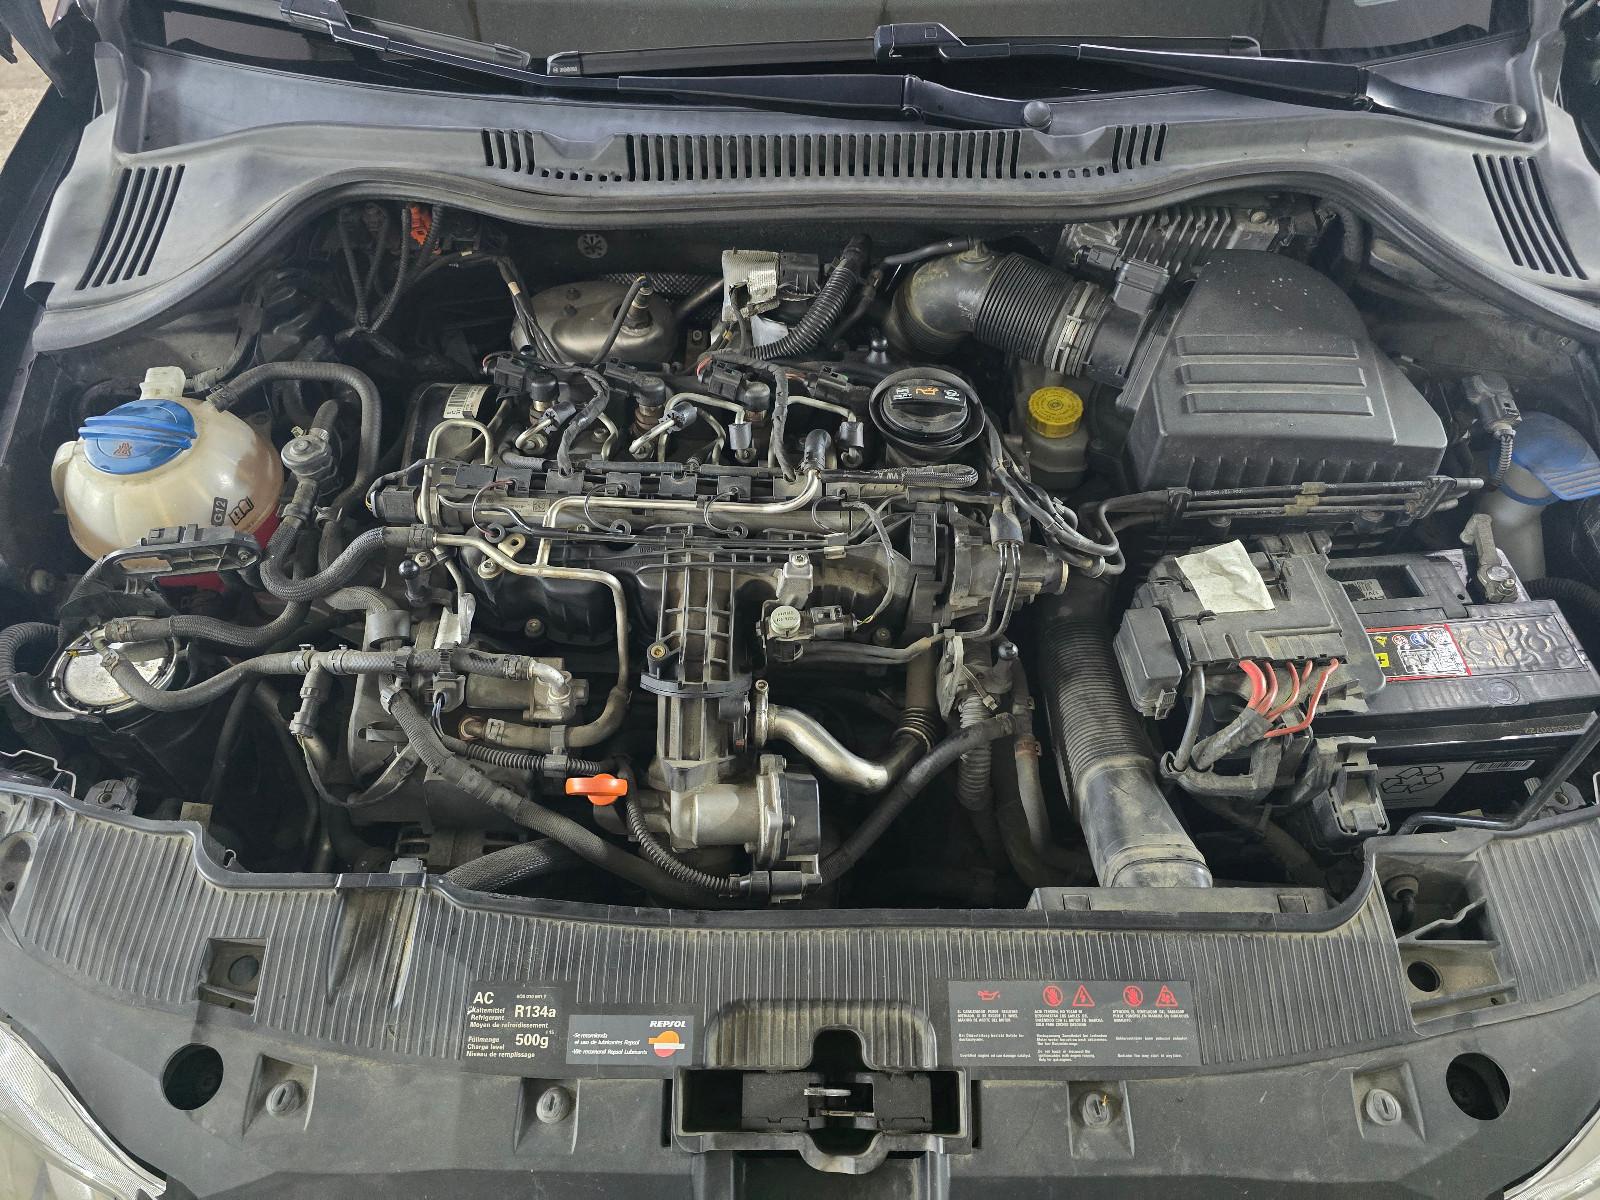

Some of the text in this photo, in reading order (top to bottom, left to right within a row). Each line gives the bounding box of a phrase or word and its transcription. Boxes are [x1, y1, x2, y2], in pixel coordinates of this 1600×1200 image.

[213, 500, 226, 523] G12
[473, 991, 495, 1004] AC
[514, 1004, 556, 1018] R134a
[649, 1020, 686, 1028] REPSOL
[515, 1033, 549, 1049] 500g
[498, 1051, 535, 1059] remplissage
